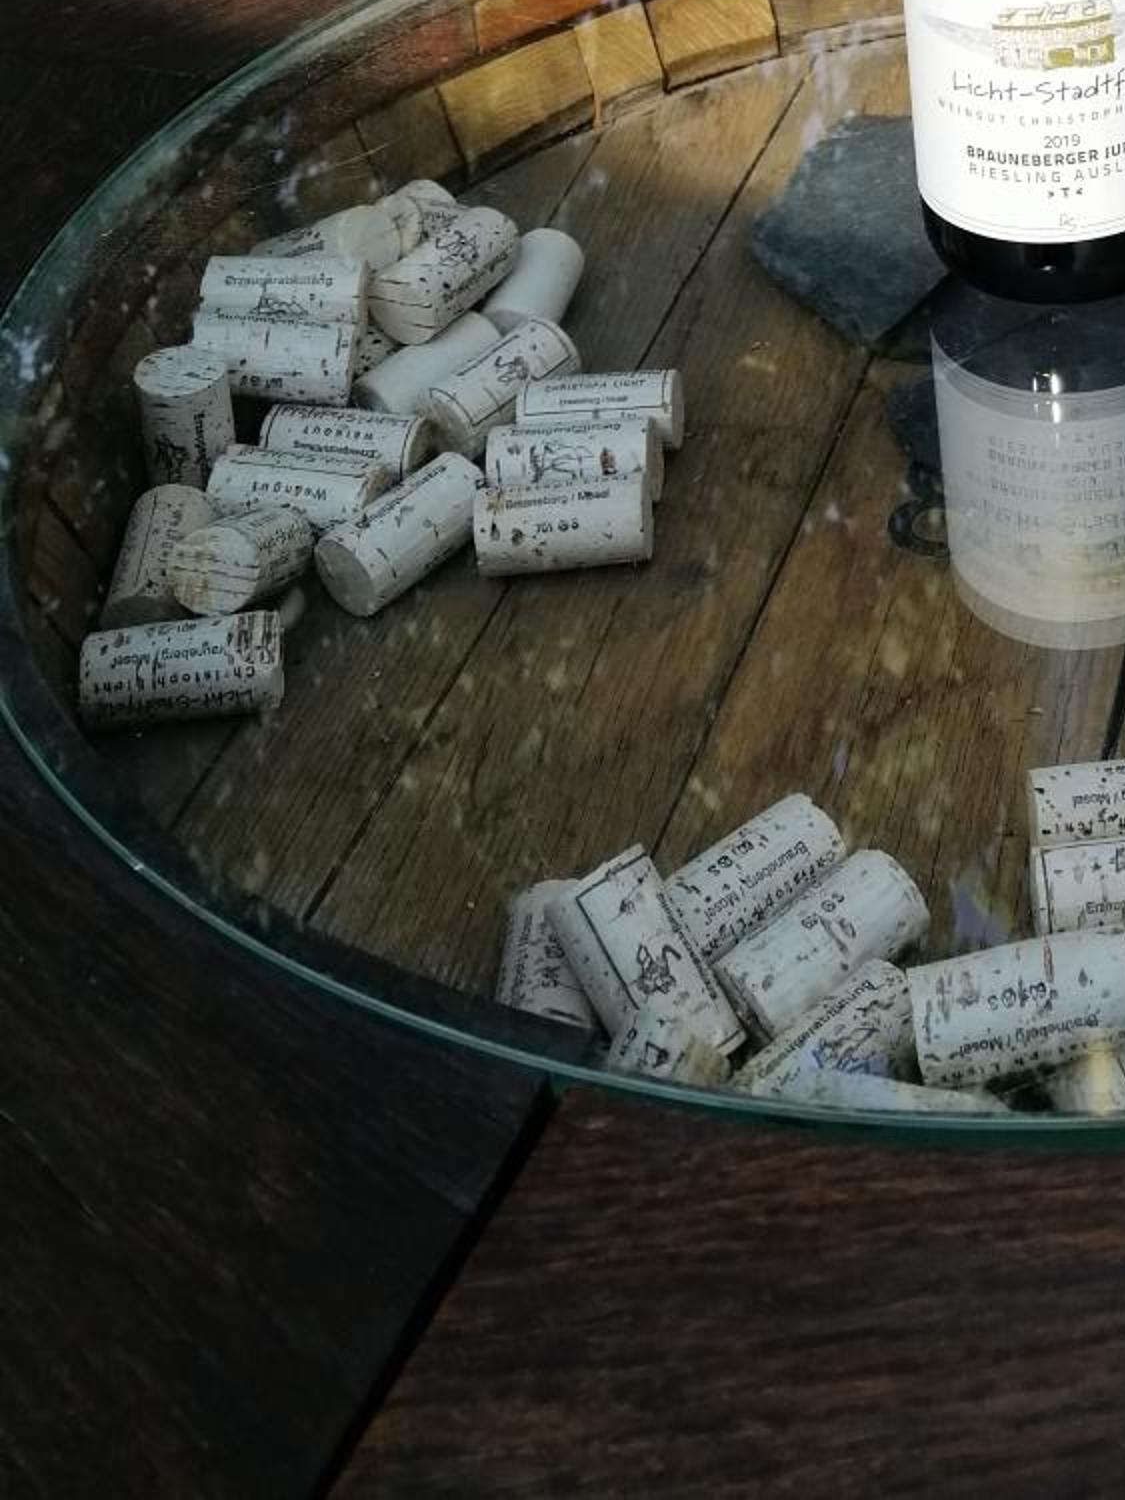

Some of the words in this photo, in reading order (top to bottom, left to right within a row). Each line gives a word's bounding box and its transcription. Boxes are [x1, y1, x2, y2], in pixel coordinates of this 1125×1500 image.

[1043, 134, 1081, 148] 2019
[967, 145, 1099, 166] BRAUNEBERGER
[969, 162, 1060, 182] RIESLING
